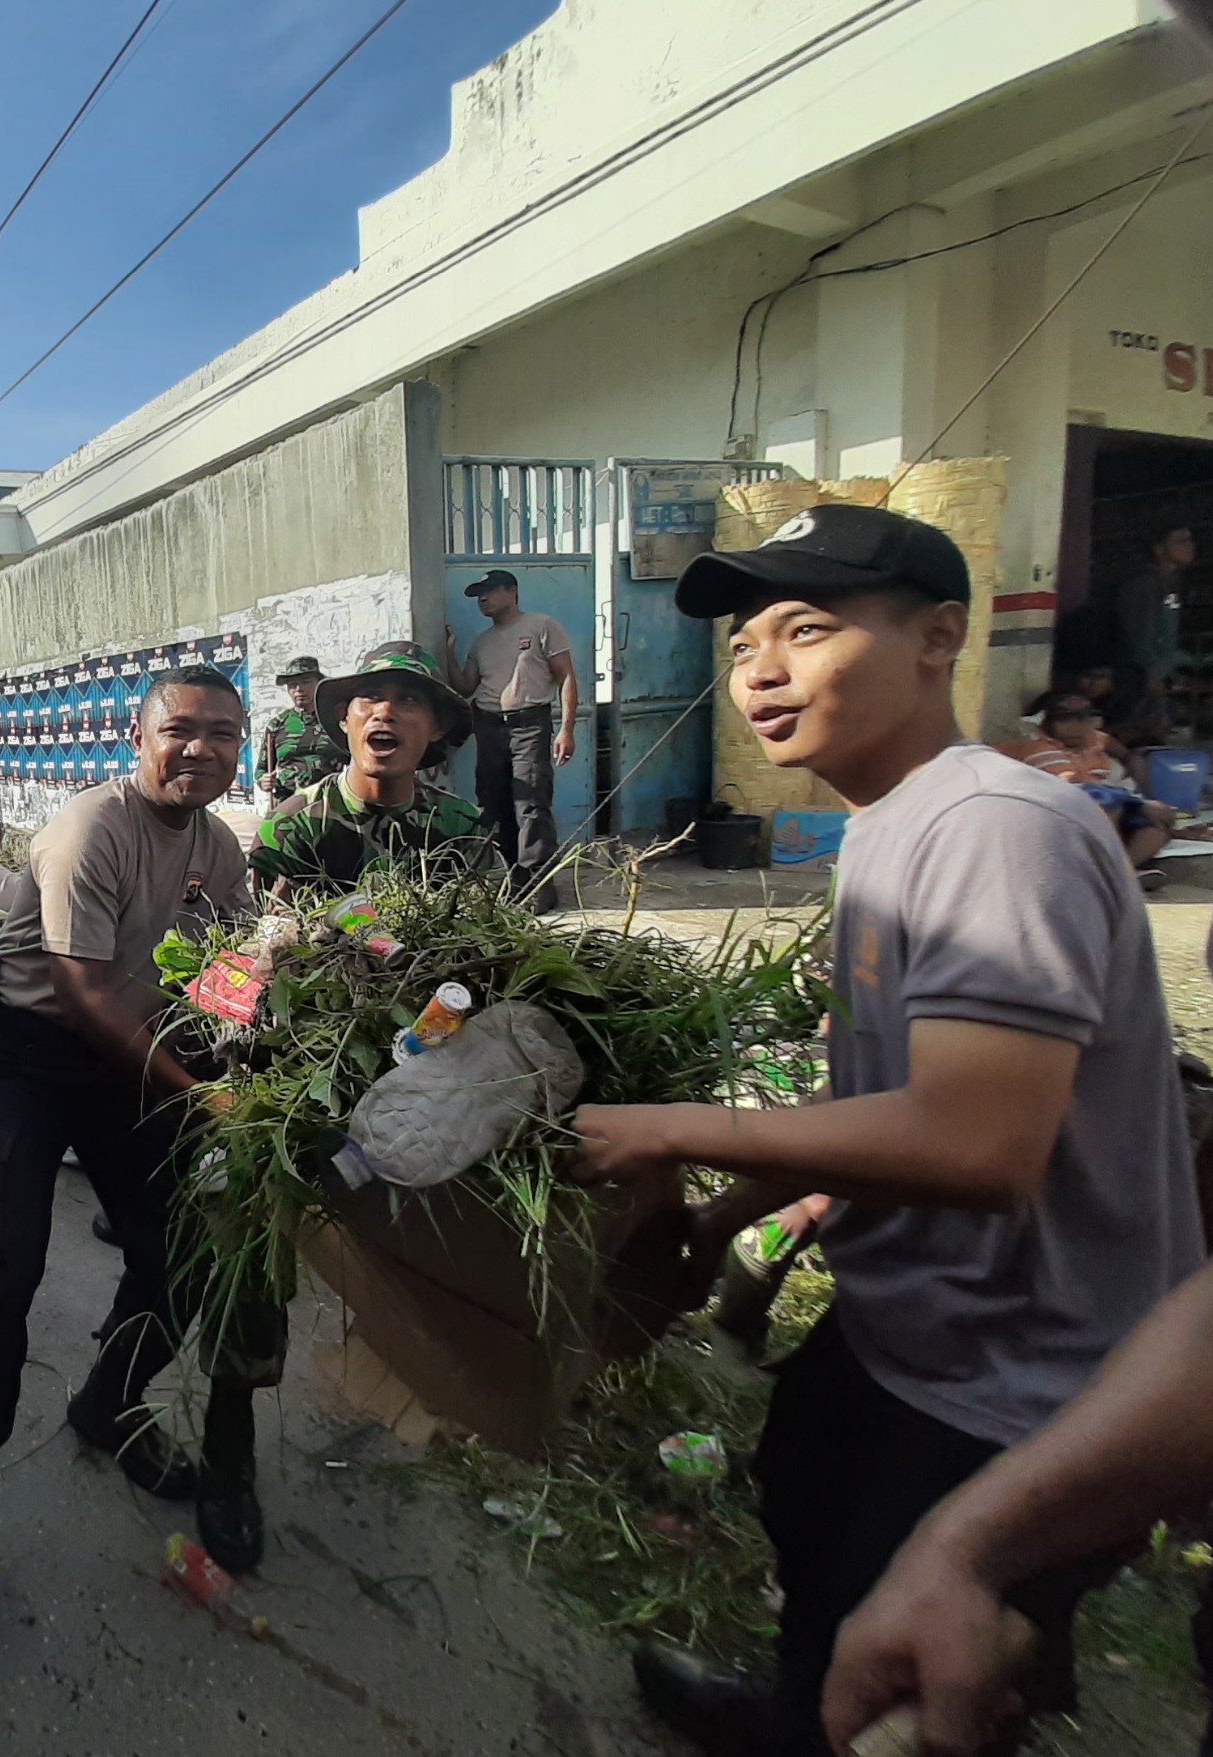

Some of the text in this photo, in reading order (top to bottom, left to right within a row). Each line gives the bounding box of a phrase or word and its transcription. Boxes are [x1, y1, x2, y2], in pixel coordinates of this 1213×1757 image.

[1109, 330, 1158, 352] TOKO
[97, 666, 115, 679] ZIGA
[120, 662, 142, 676] ZIGA
[147, 657, 172, 672] ZIGA
[179, 652, 205, 667] ZIGA
[213, 646, 243, 663] ZIGA
[99, 729, 119, 741] ZIGA
